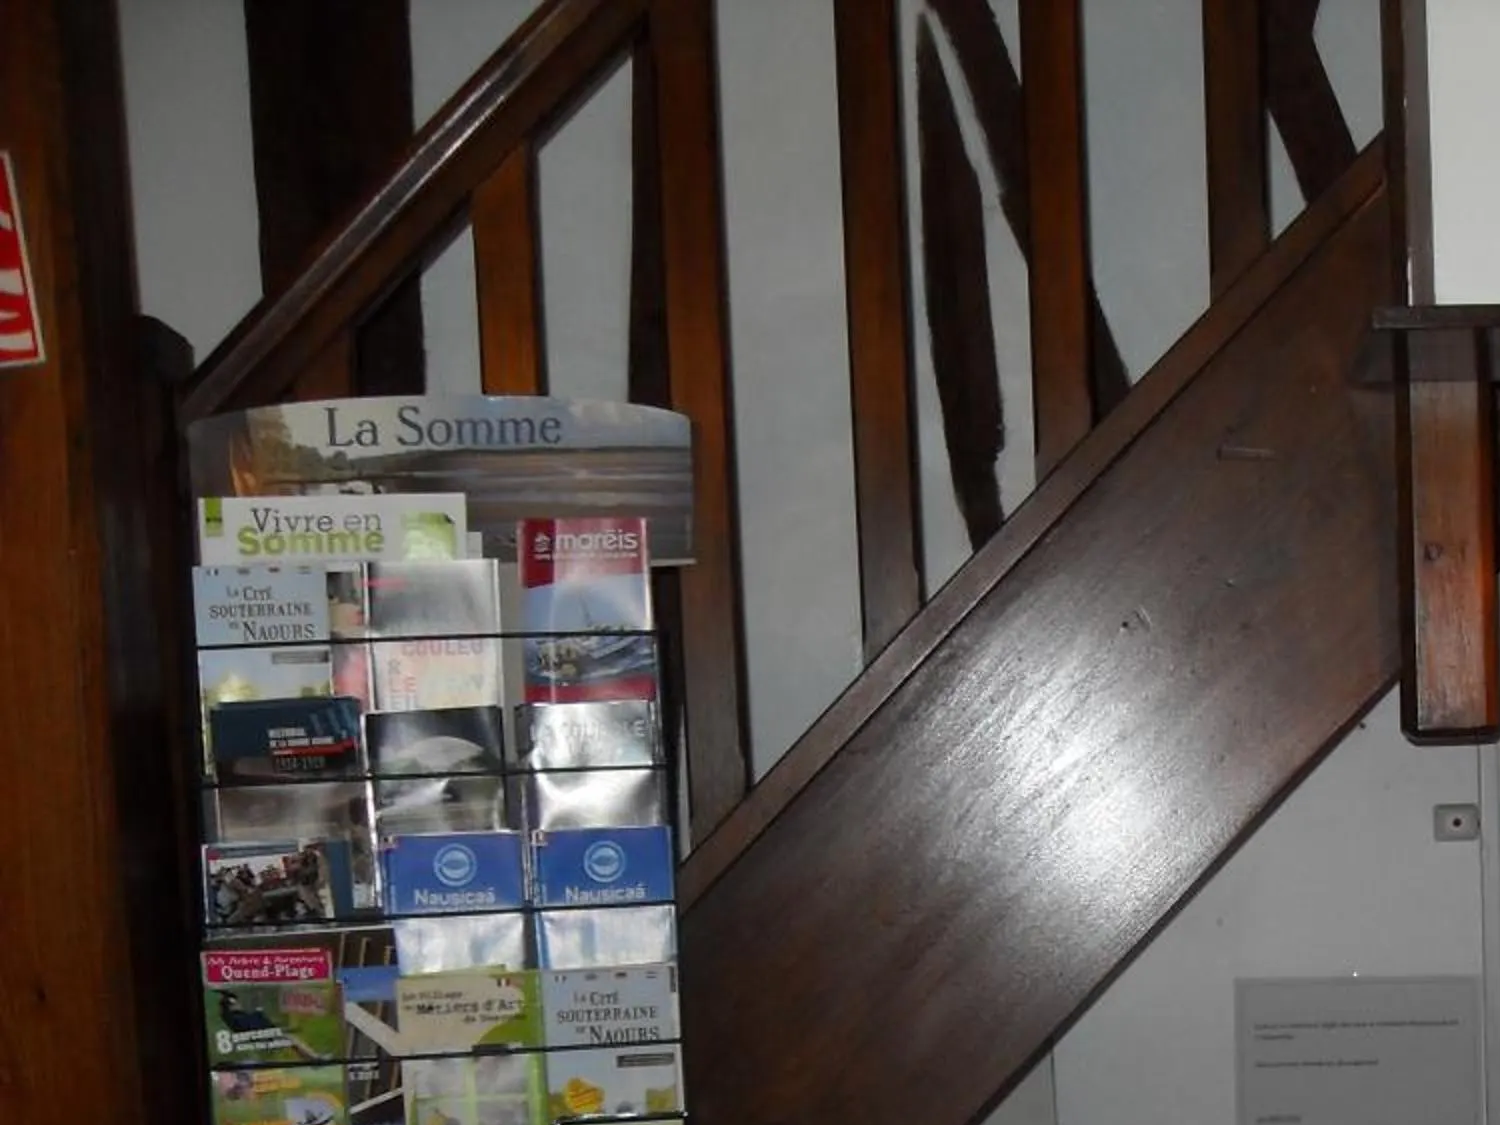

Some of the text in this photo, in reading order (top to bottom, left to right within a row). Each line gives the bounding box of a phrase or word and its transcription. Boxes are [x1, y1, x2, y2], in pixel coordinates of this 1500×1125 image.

[325, 405, 563, 447] La Somme
[251, 508, 383, 533] Vivre en
[238, 526, 385, 556] Somme
[208, 602, 315, 619] SOUTERRAINE
[242, 621, 317, 642] NAOURS
[220, 964, 316, 981] Quend-Plage
[556, 1005, 658, 1023] SOUTERRAINE
[215, 1029, 233, 1054] 8
[589, 1025, 660, 1044] NAOURS
